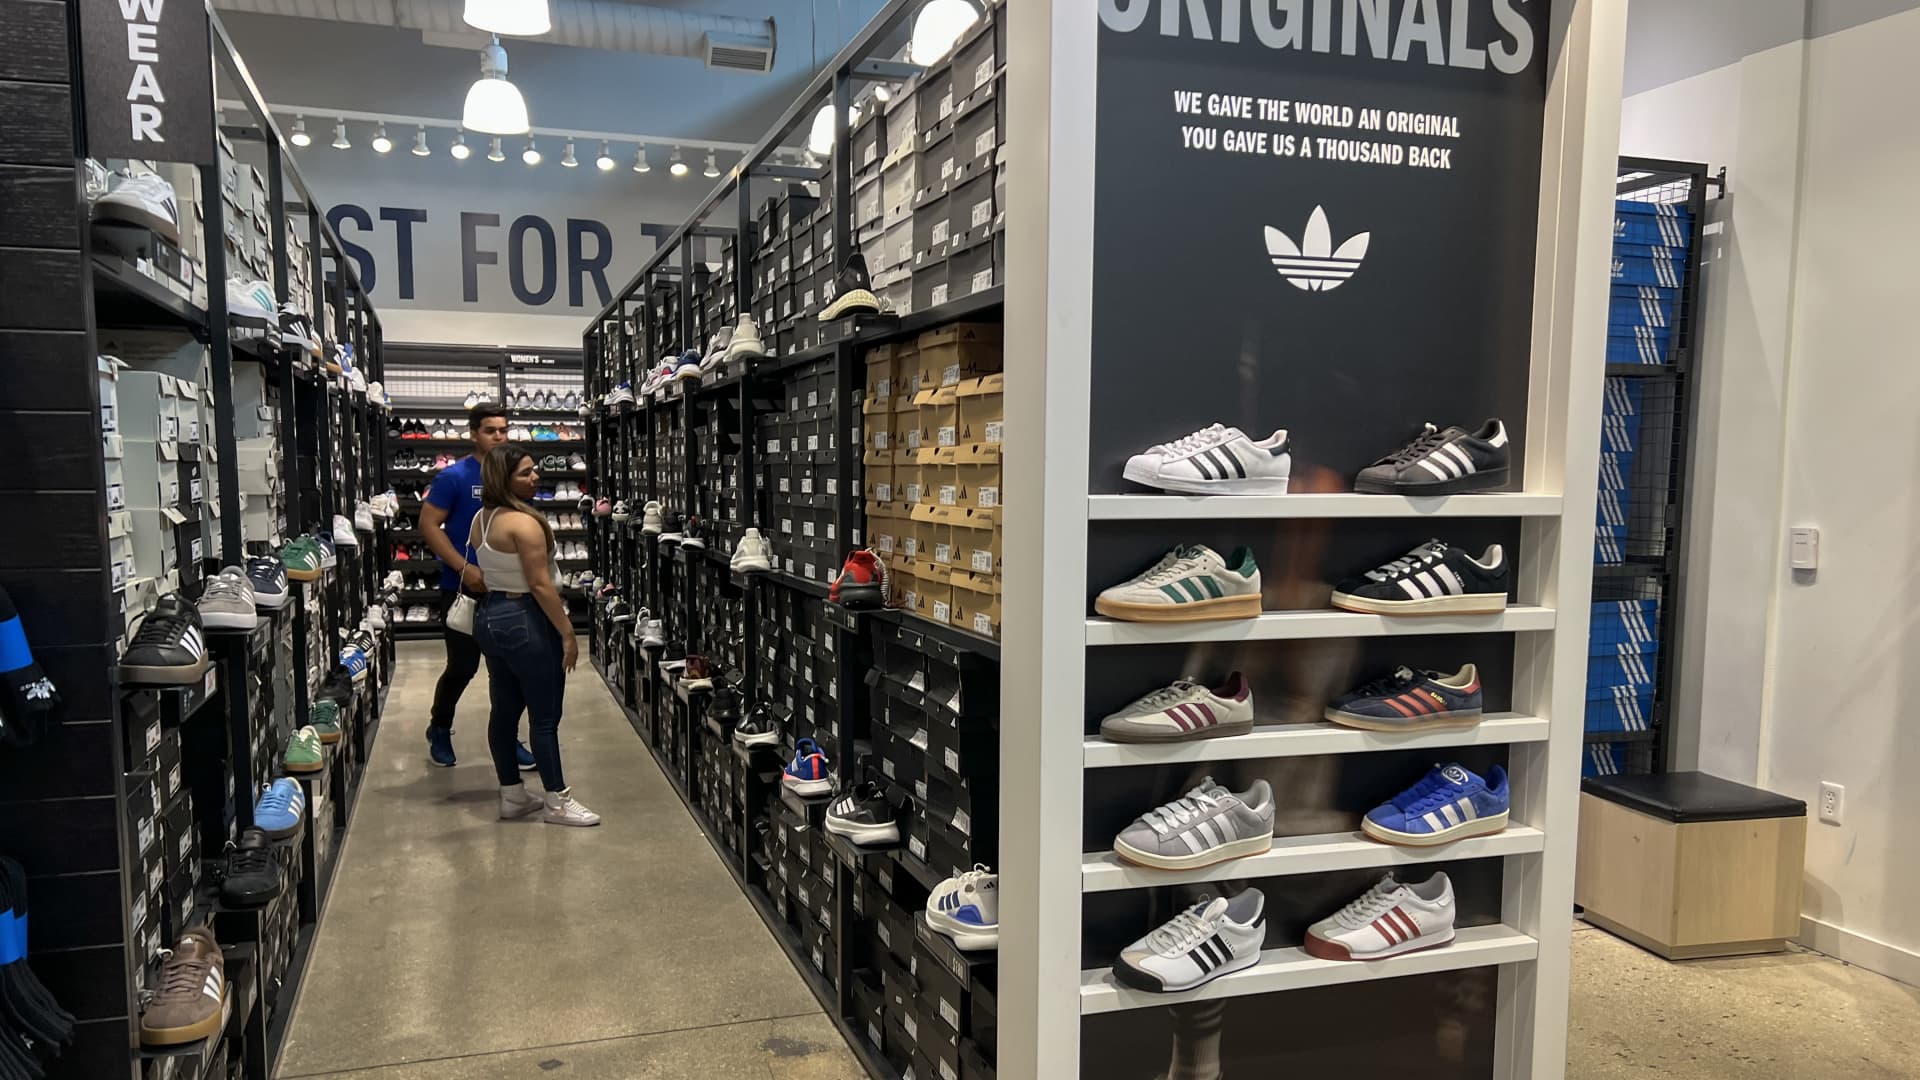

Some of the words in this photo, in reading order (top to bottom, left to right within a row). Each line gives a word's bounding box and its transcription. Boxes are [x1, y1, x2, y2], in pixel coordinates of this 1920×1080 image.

[119, 0, 165, 142] WEAR
[1174, 90, 1202, 114] WE
[1207, 93, 1253, 119] GAVE
[1257, 98, 1290, 122] THE
[1294, 101, 1354, 128] WORLD
[1358, 108, 1381, 131] AN
[1386, 110, 1460, 138] ORIGINAL
[1182, 125, 1217, 150] YOU
[1223, 129, 1267, 154] GAVE
[1272, 133, 1295, 156] US
[1299, 136, 1311, 158] A
[1316, 138, 1403, 165] THOUSAND
[1408, 145, 1452, 169] BACK
[461, 212, 613, 307] FOR
